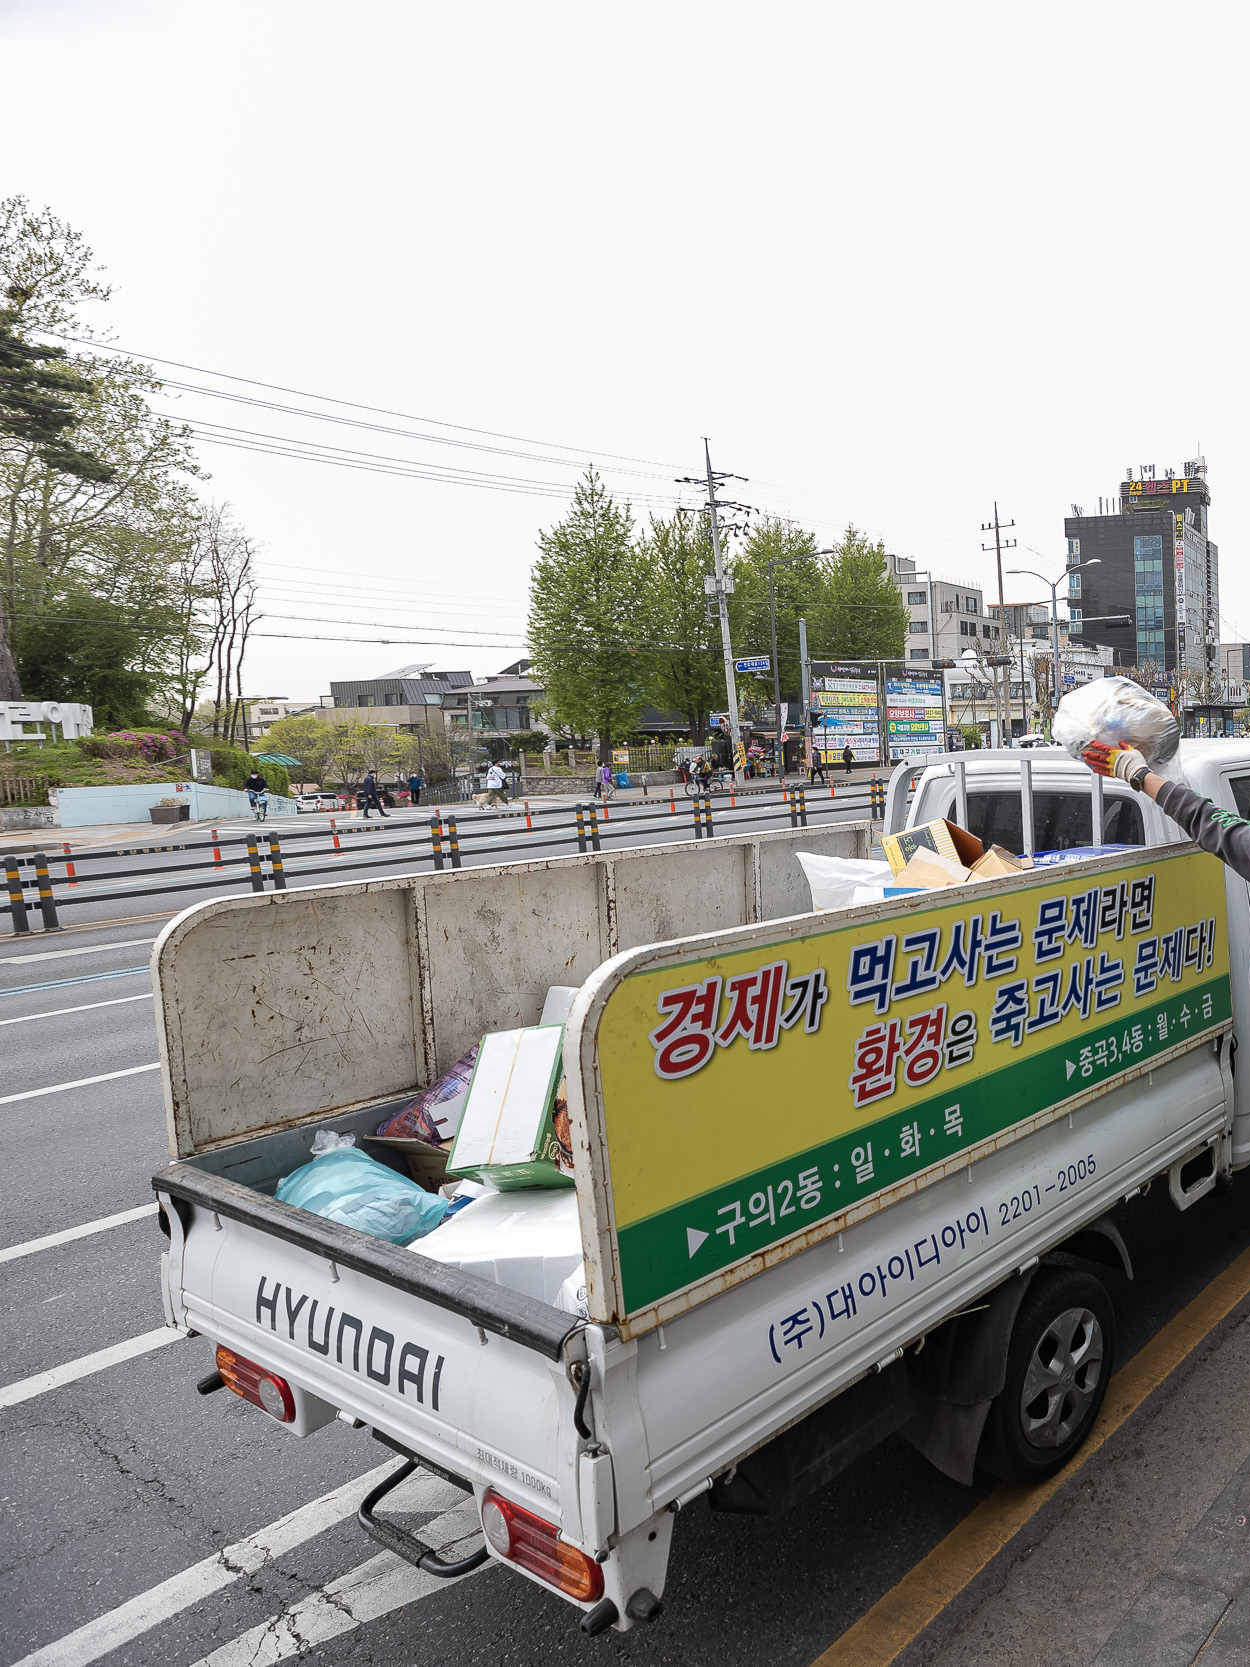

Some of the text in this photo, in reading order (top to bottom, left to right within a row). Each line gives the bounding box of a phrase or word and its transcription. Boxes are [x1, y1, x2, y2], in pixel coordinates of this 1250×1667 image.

[1129, 481, 1142, 491] 24
[1145, 479, 1190, 495] 헬스 PT
[648, 874, 1157, 1080] 경제가 먹고사는 문제라면
[848, 917, 1217, 1108] 환경은 죽고사는 문제다!
[1078, 1025, 1144, 1079] 중곡3,4동
[715, 1167, 822, 1247] 구의2동
[767, 1153, 1097, 1364] (주)대아이디아이 2201-2005
[256, 1275, 446, 1413] HYUNDAI
[477, 1448, 552, 1497] 최대적재량 1000kg
